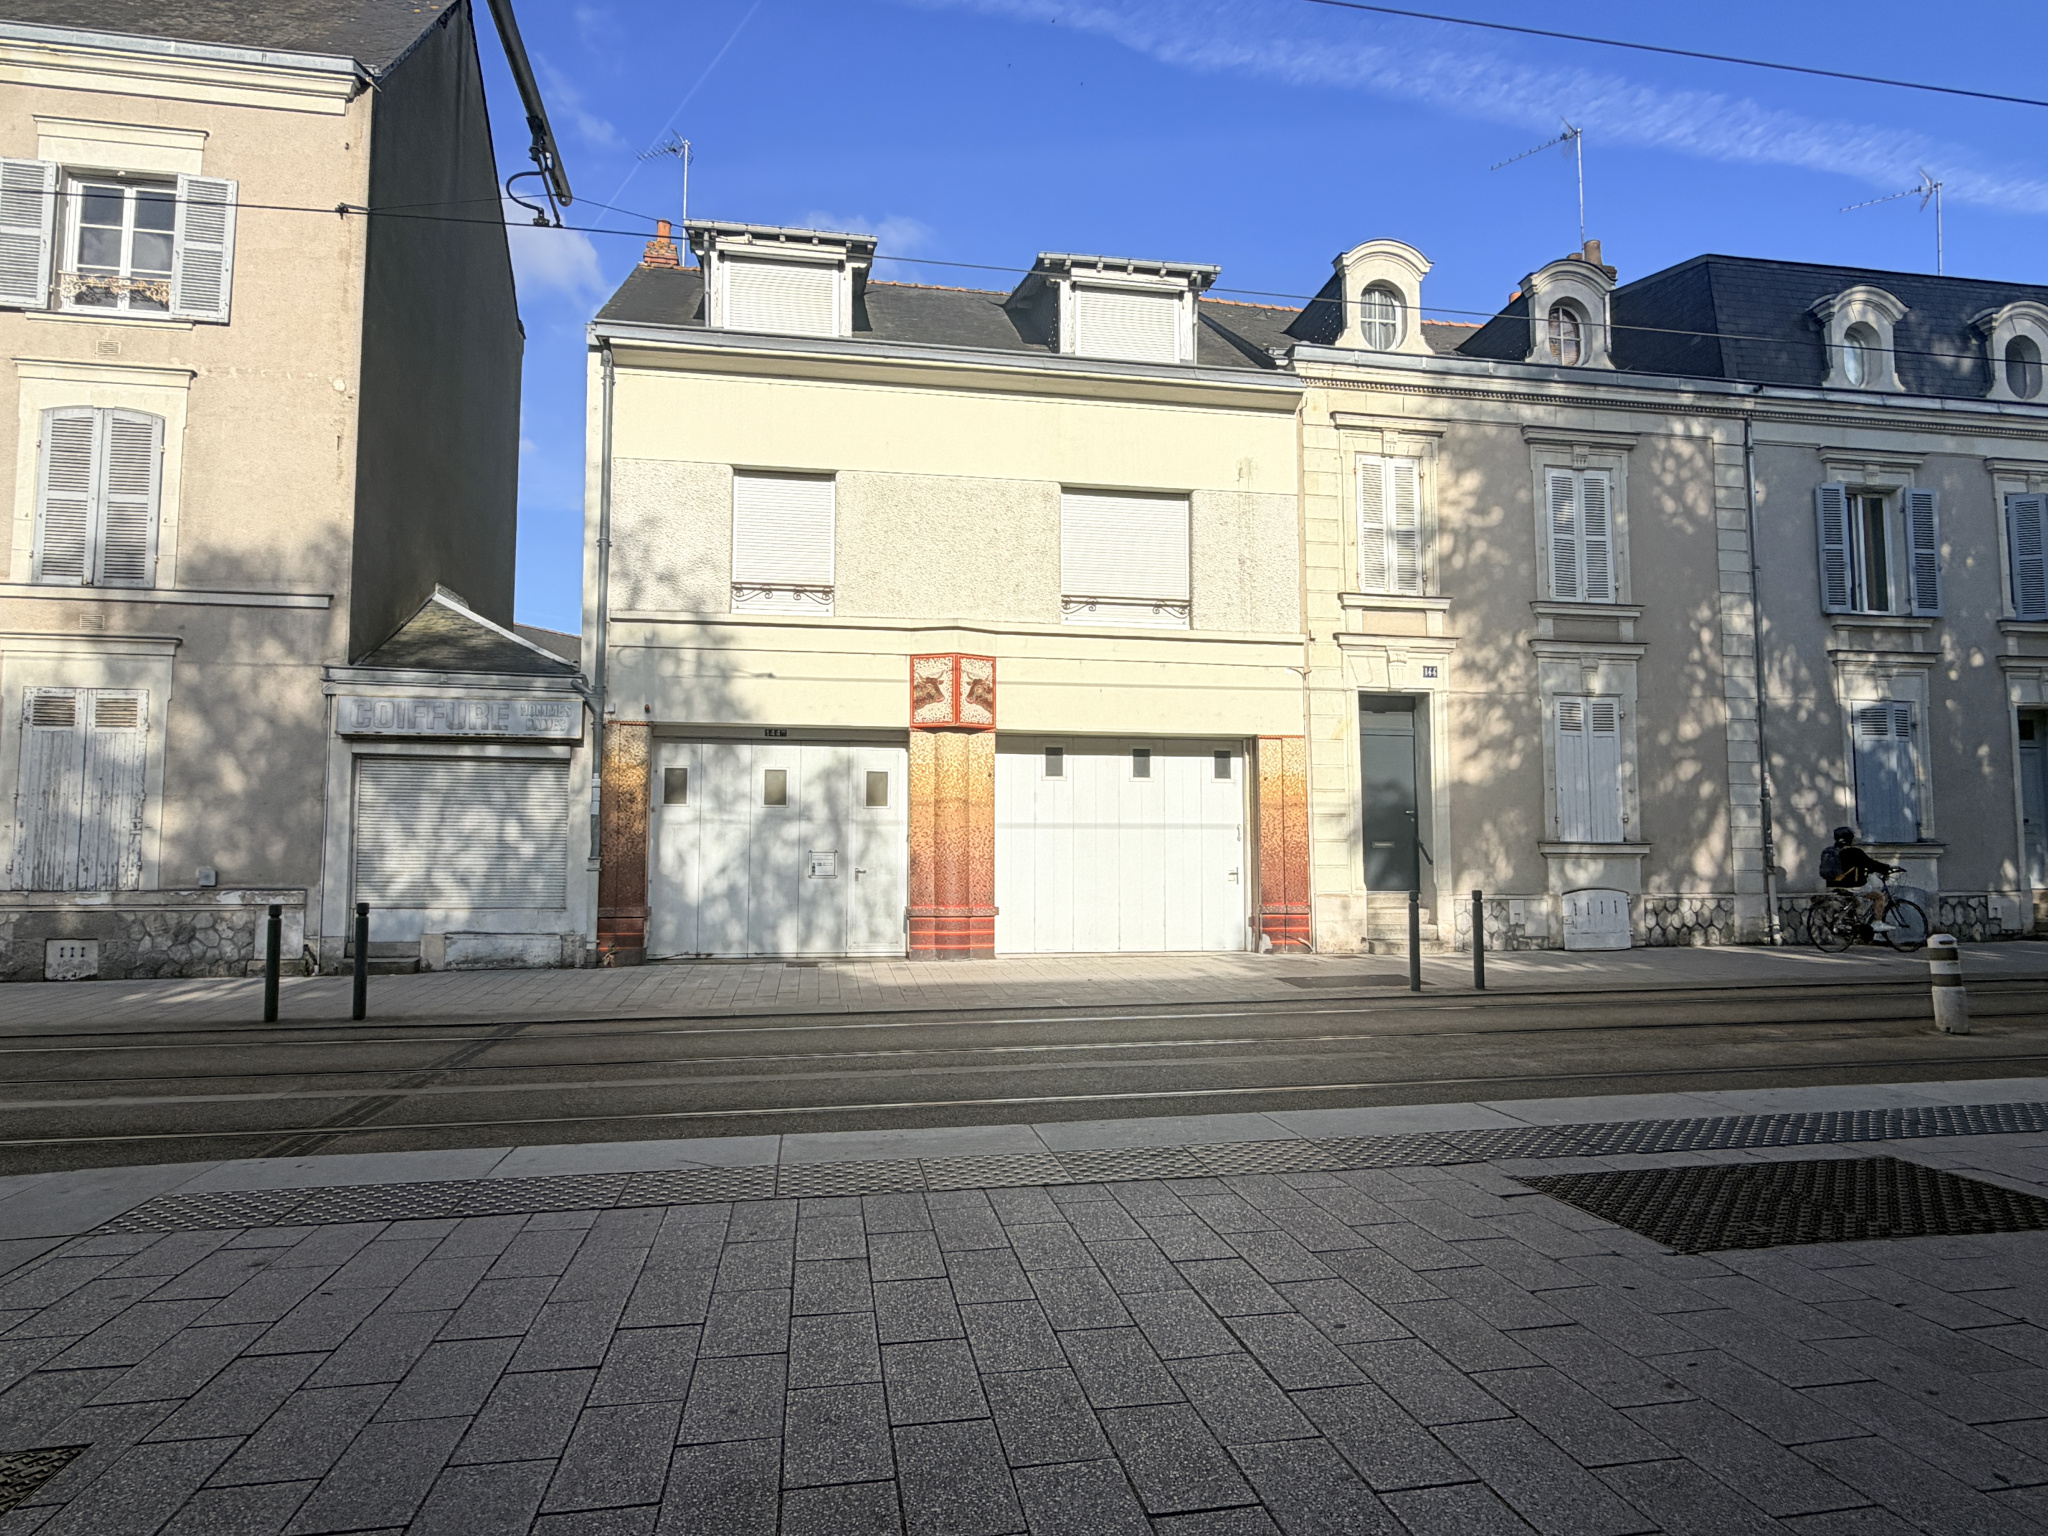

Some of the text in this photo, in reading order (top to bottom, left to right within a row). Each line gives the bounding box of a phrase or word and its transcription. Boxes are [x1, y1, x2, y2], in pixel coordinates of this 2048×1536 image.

[350, 700, 510, 731] COIFFURE
[520, 703, 572, 717] HOMMES
[526, 718, 566, 731] DAMES
